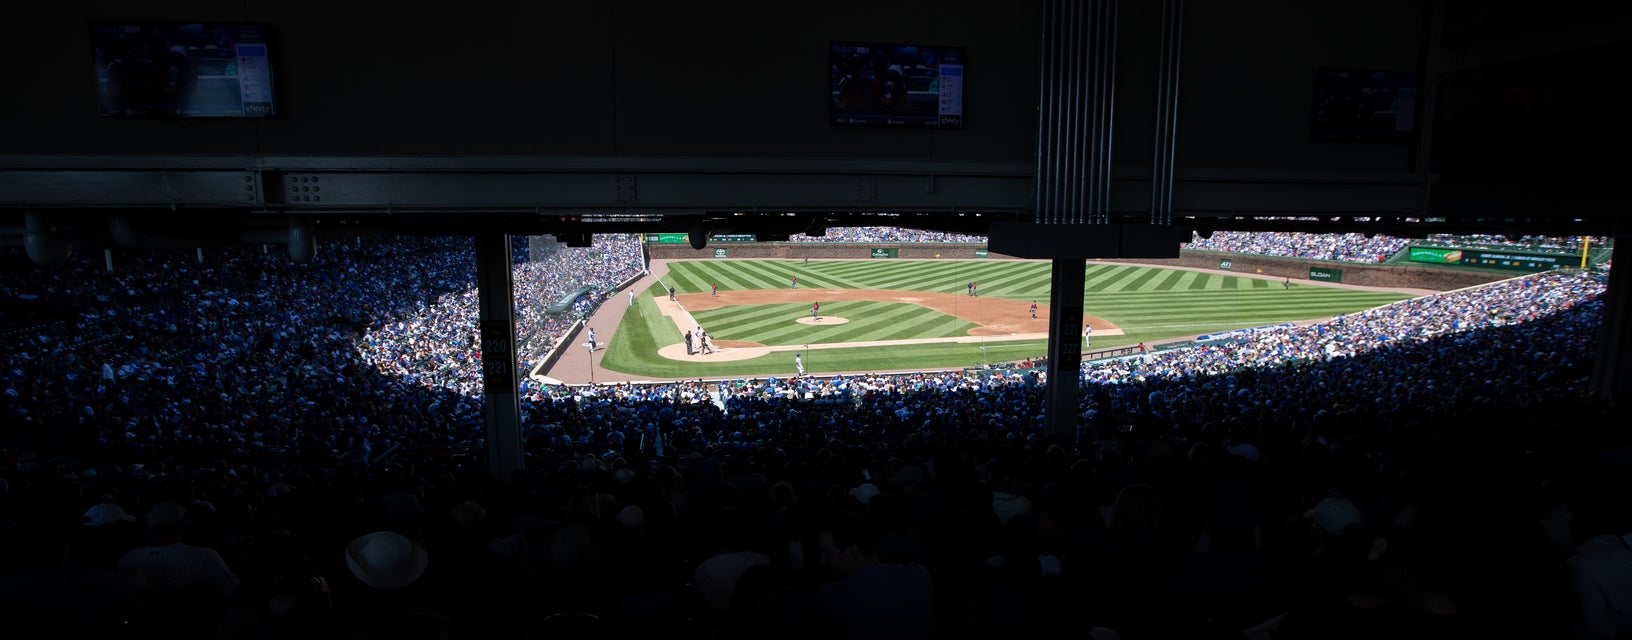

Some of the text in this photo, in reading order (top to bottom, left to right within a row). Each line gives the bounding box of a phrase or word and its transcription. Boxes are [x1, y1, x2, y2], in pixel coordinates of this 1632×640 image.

[1310, 271, 1331, 279] SLOAN
[486, 339, 507, 353] 220
[1062, 343, 1080, 355] 222
[488, 361, 507, 375] 221
